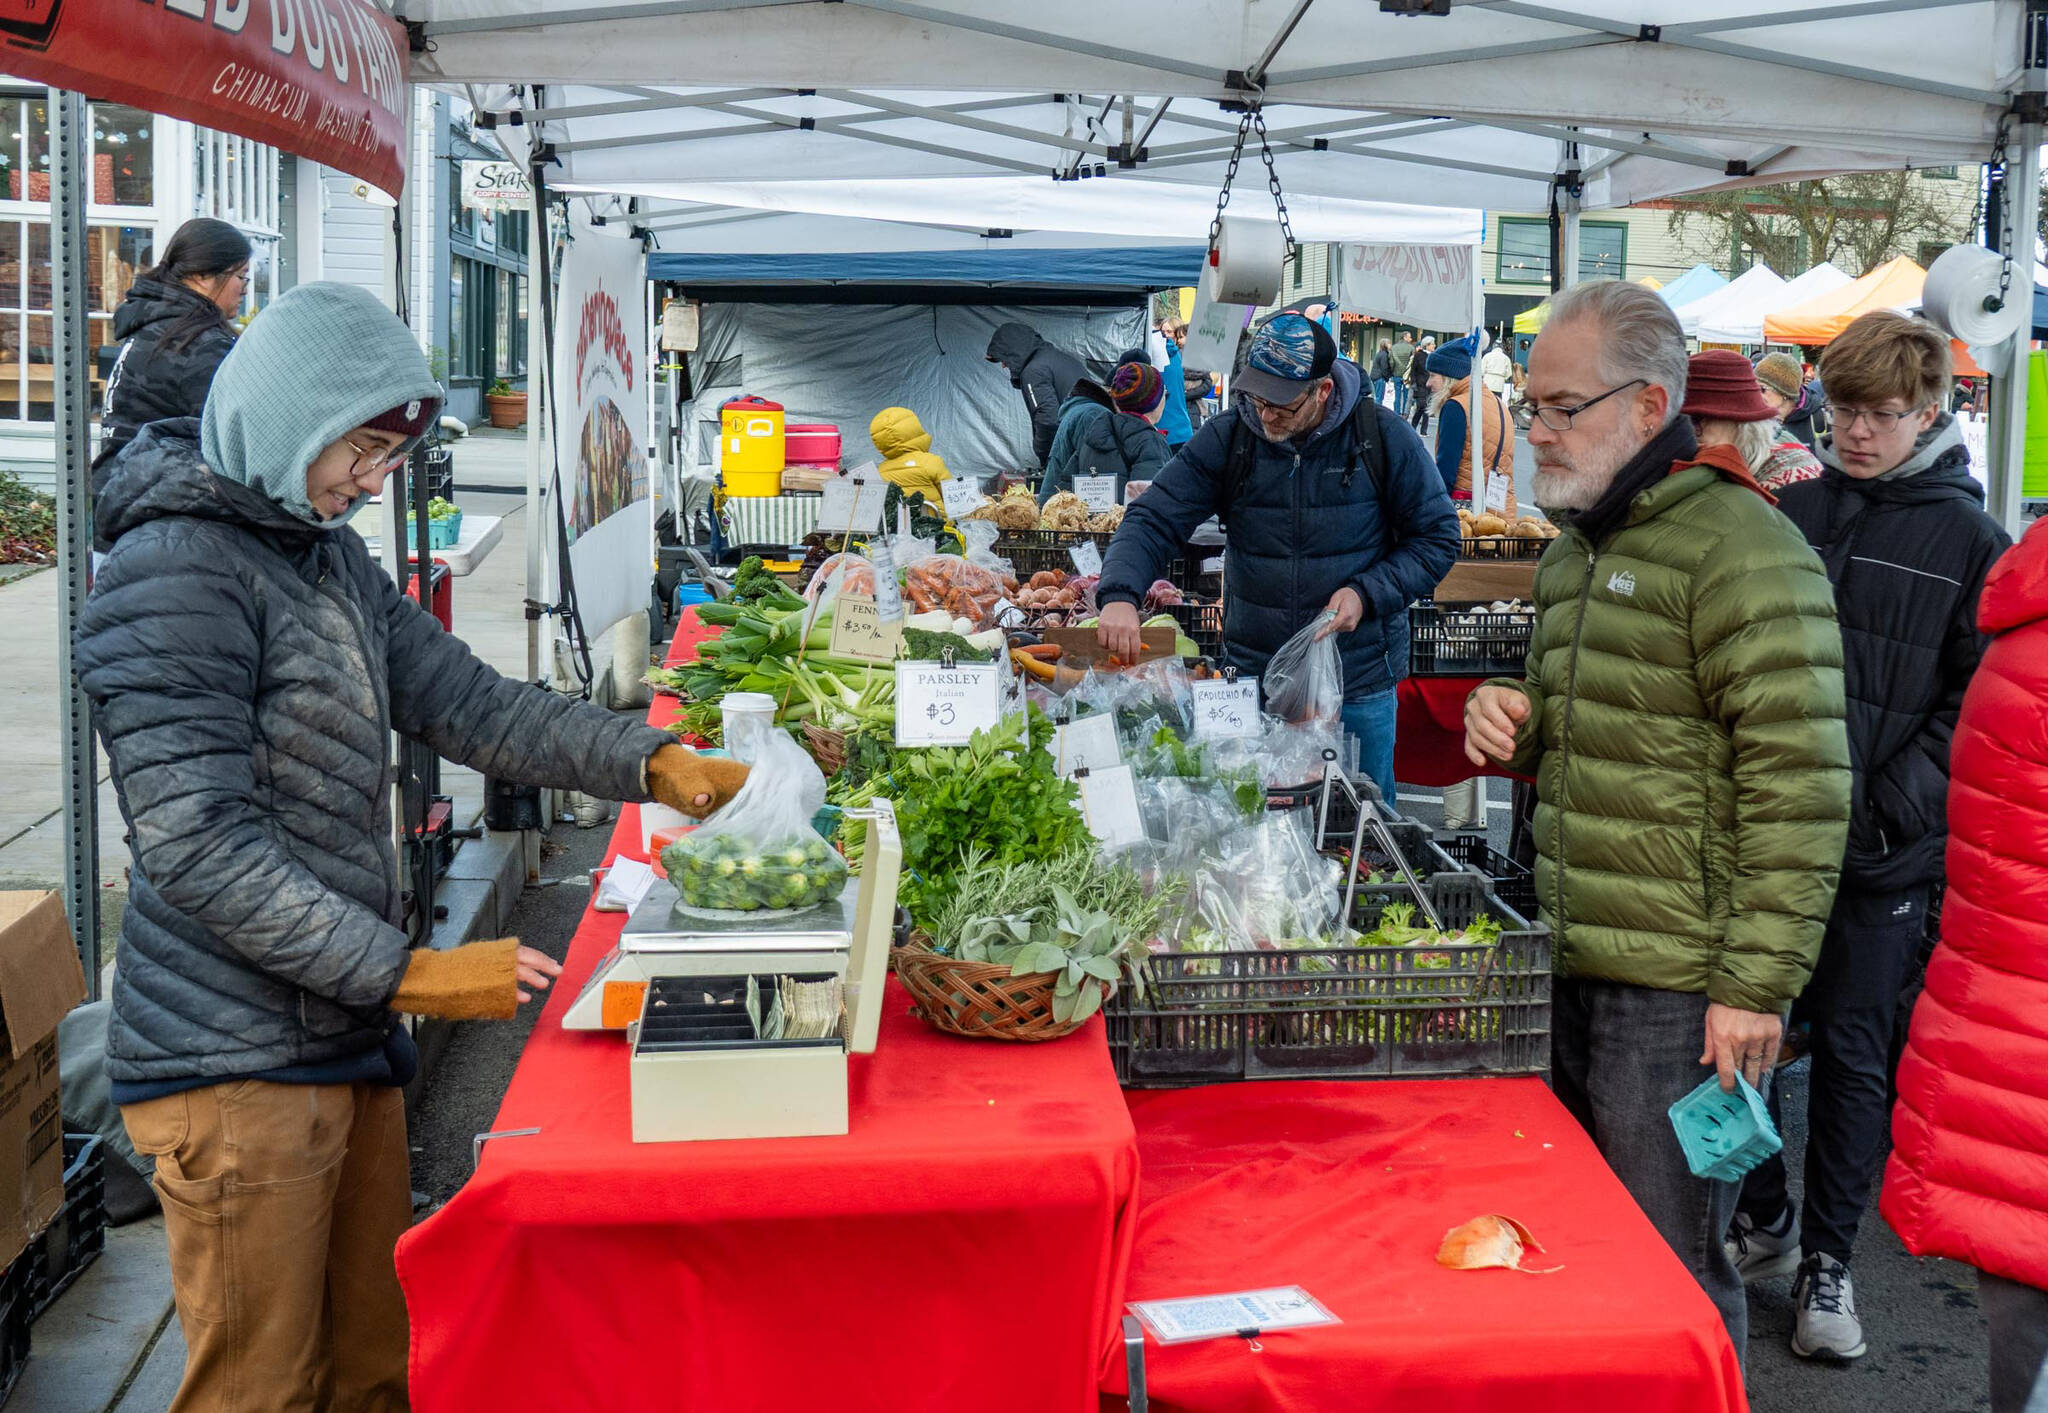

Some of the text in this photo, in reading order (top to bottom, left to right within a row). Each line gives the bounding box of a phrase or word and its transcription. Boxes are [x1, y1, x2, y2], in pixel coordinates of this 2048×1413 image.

[211, 62, 384, 155] CHIMACUM, WASHINGTON
[918, 673, 982, 686] PARSLEY
[935, 688, 966, 698] Italian
[925, 702, 956, 726] $3
